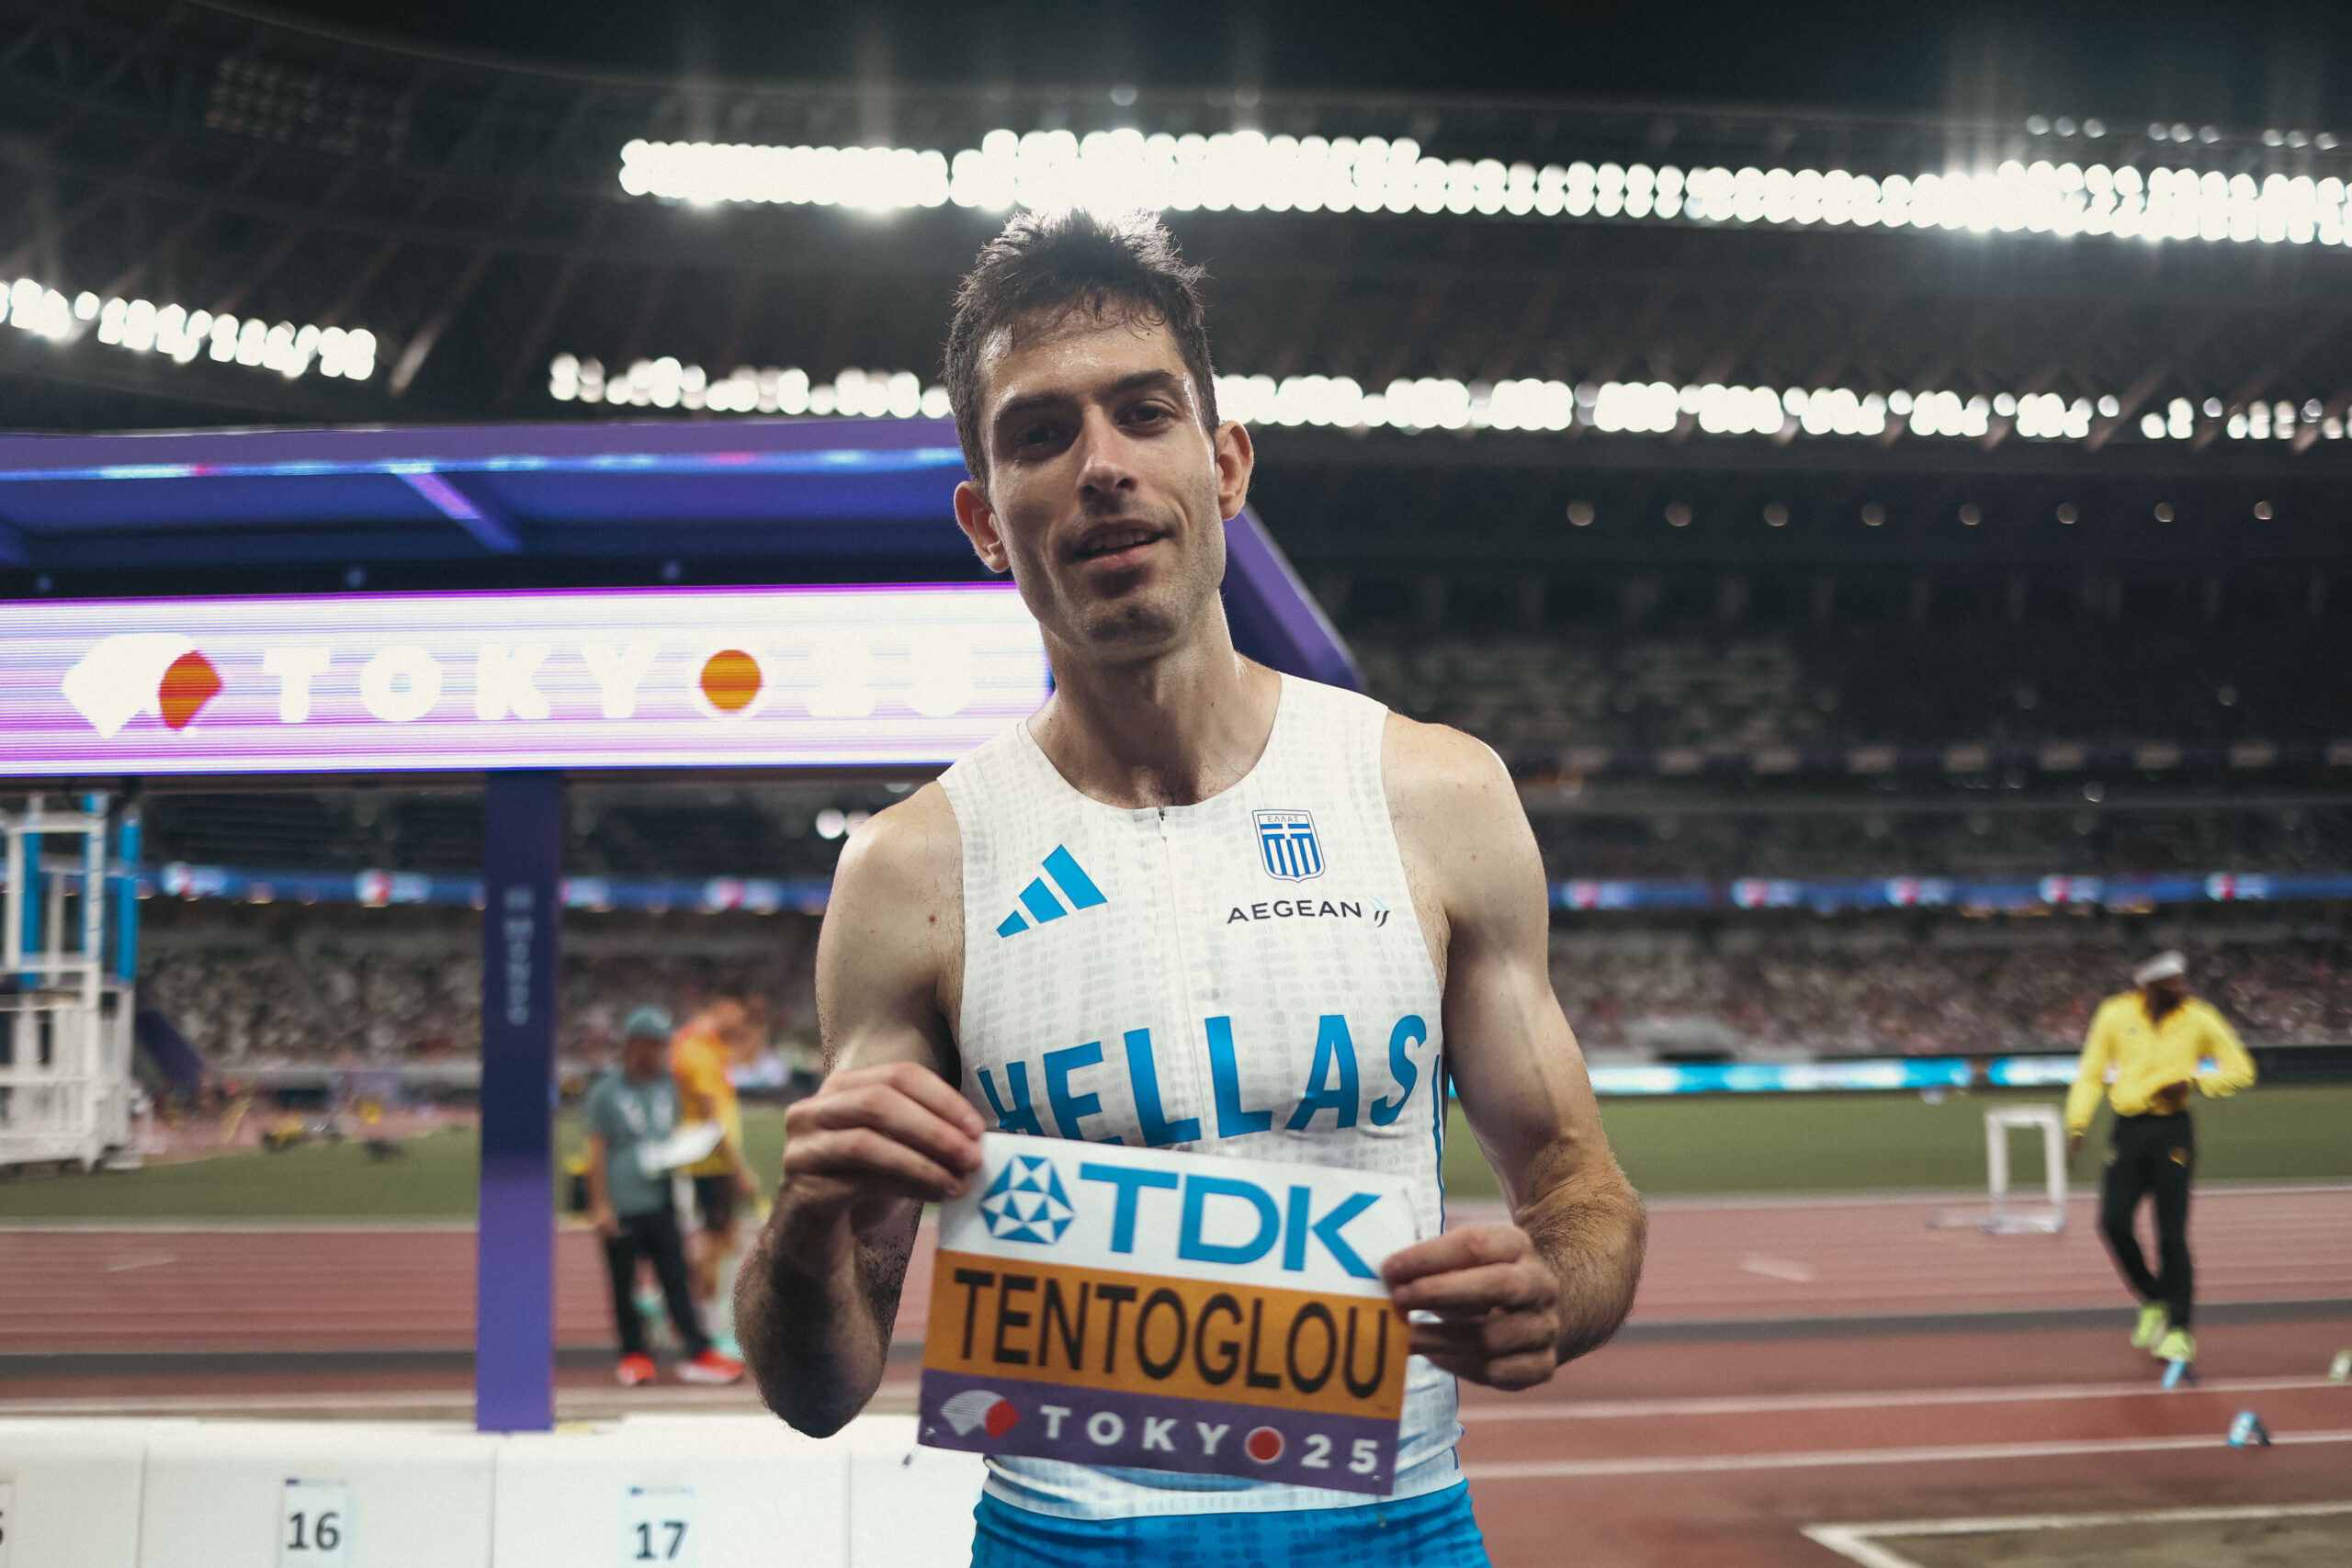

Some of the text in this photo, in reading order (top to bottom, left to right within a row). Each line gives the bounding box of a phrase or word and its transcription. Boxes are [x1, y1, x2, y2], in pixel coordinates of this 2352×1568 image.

[1227, 899, 1363, 924] AEGEAN
[977, 1014, 1429, 1147] HELLAS
[1079, 1162, 1383, 1280] TDK
[954, 1269, 1393, 1399] TENTOGLOU
[288, 1512, 341, 1551] 16
[636, 1520, 688, 1560] 17
